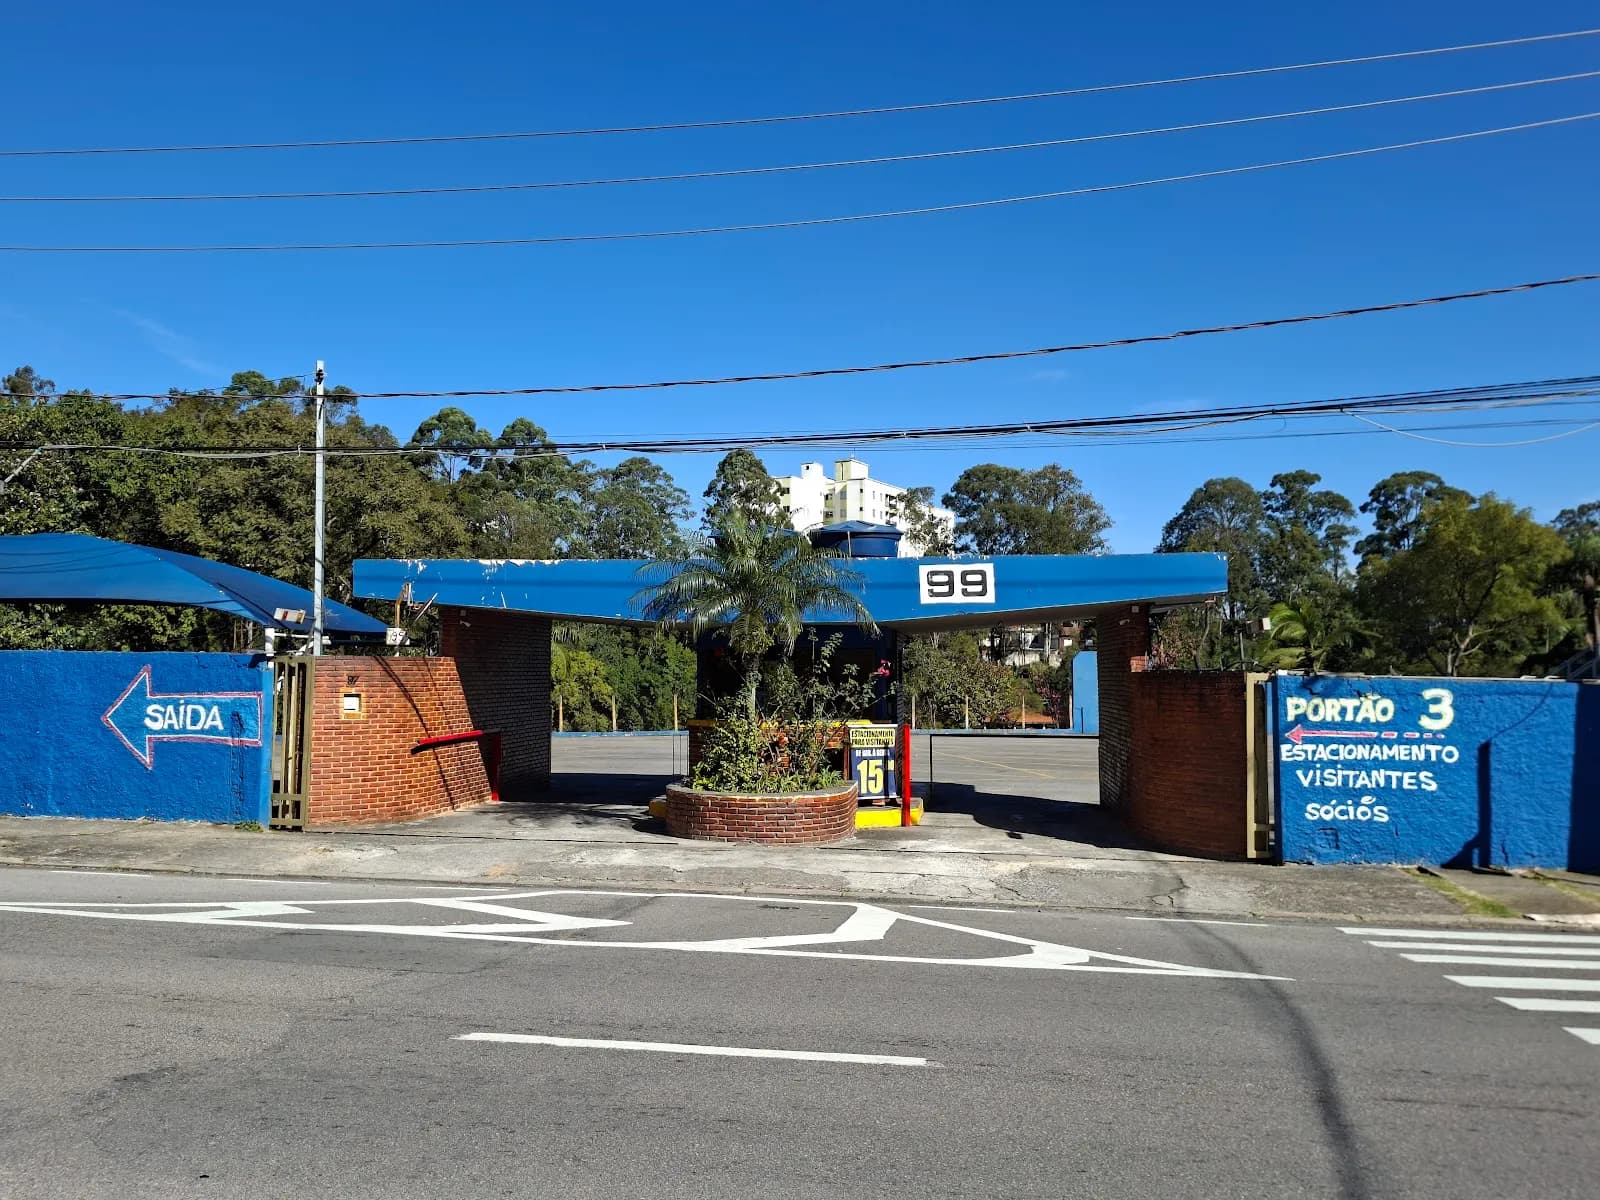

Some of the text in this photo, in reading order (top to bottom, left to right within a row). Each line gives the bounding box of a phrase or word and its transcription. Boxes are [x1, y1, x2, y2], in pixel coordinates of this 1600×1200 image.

[927, 570, 988, 597] 99
[144, 700, 224, 730] SAÍDA
[1286, 687, 1455, 730] PORTÃO 3
[1280, 744, 1459, 763] ESTACIONAMENTO
[857, 760, 884, 794] 15
[1296, 764, 1438, 791] VISITANTES
